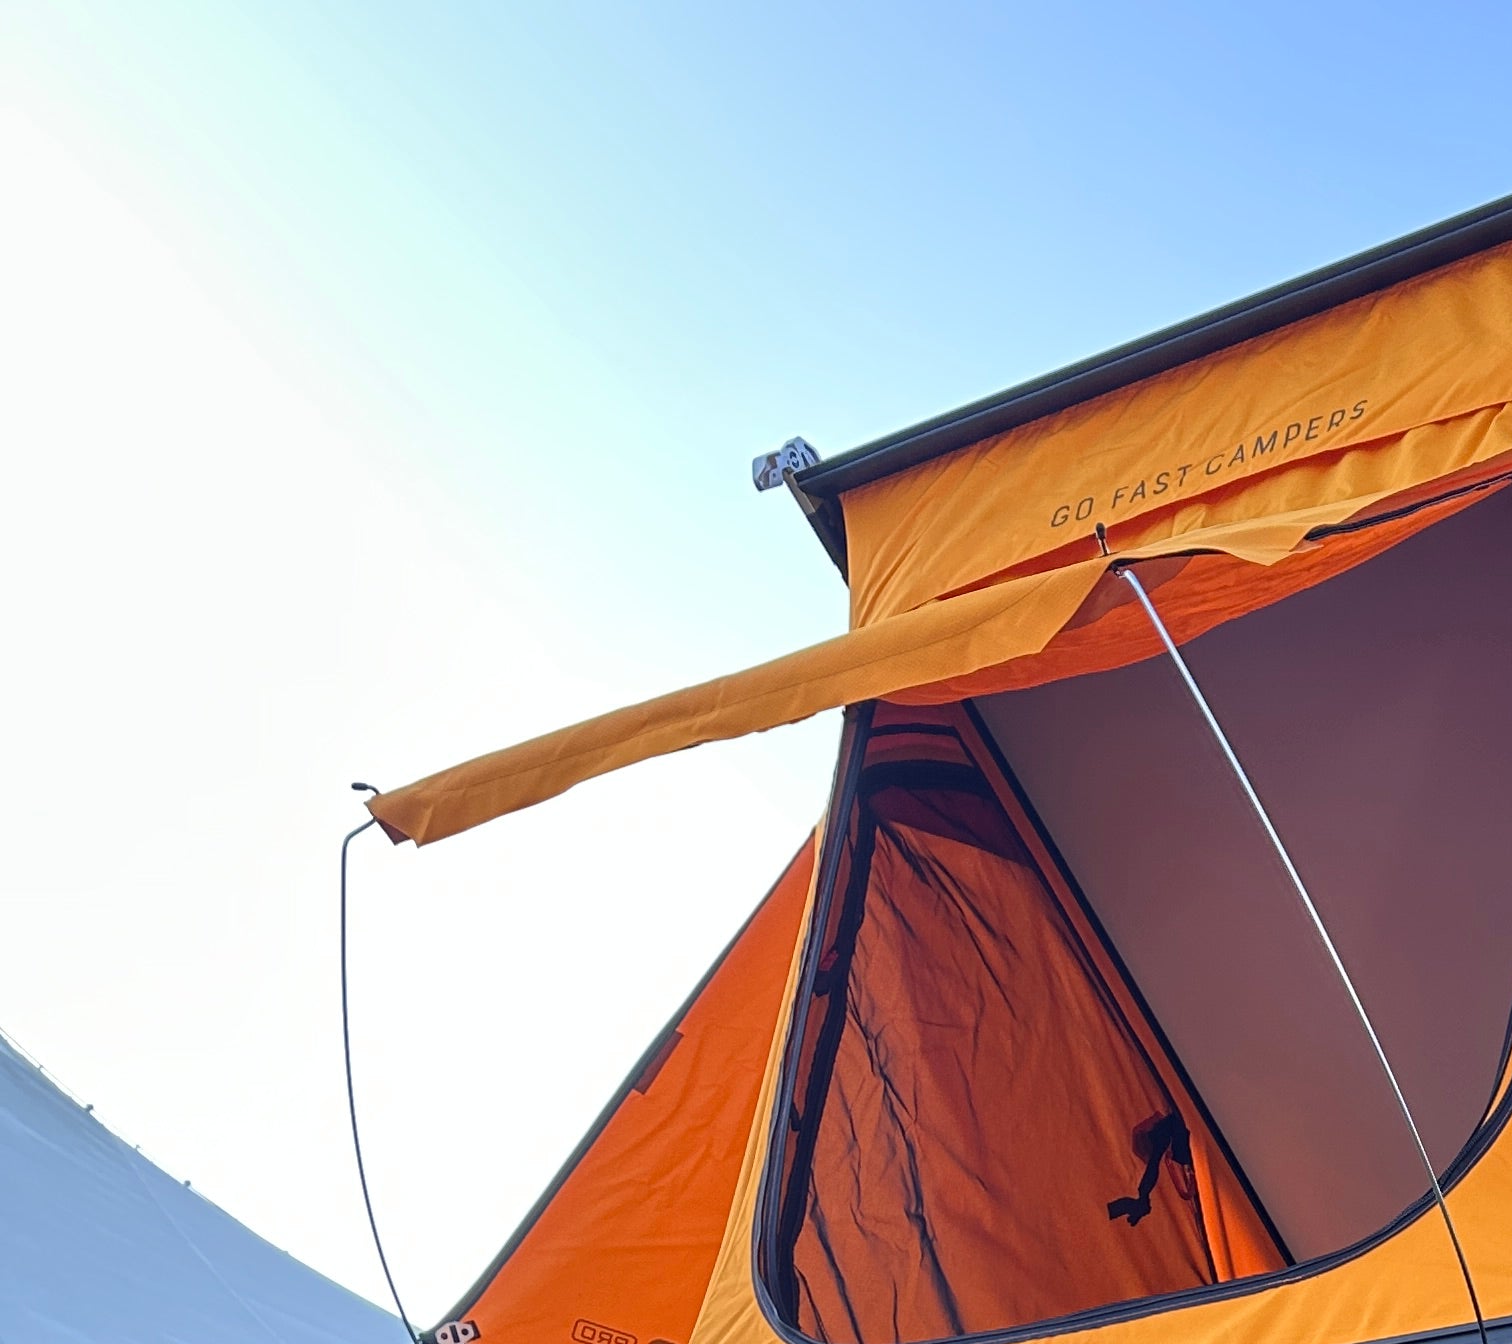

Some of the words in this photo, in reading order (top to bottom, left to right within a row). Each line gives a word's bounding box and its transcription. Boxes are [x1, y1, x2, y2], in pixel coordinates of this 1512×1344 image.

[1050, 497, 1094, 529] GO
[1111, 464, 1192, 509] FAST
[1204, 400, 1368, 476] CAMPERS
